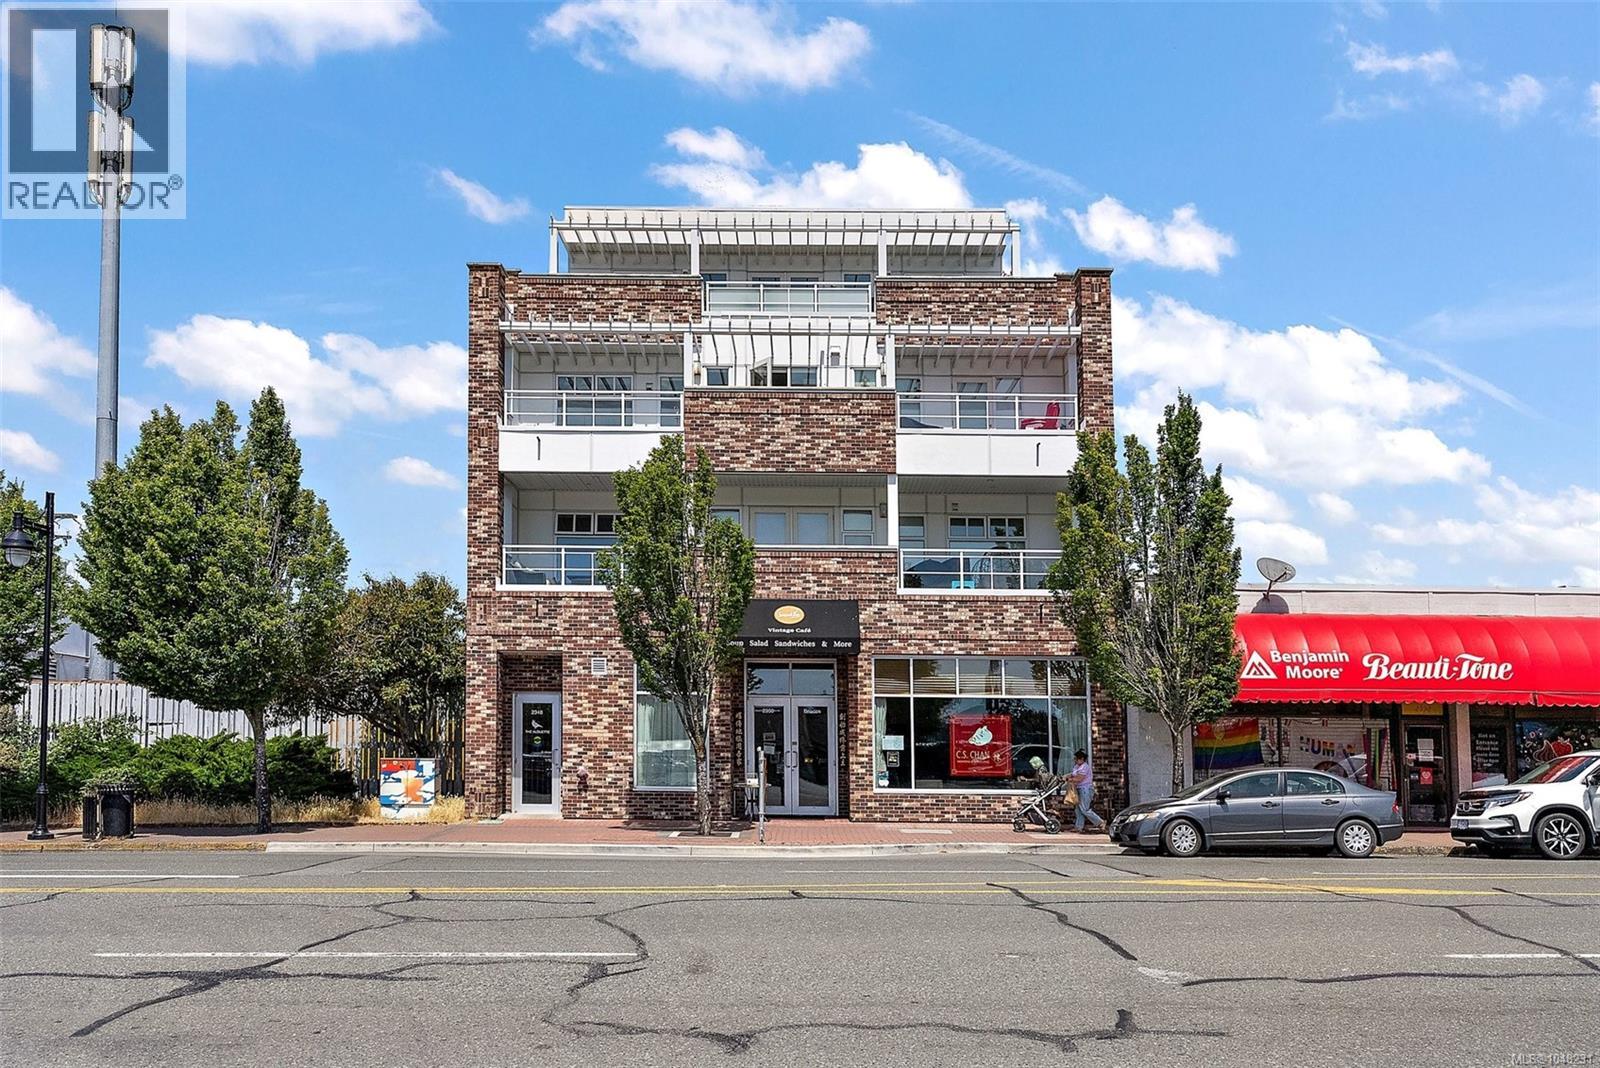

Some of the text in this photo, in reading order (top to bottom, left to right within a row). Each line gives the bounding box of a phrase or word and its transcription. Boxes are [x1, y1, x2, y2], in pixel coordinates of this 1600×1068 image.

[1270, 651, 1349, 665] Benjamin
[1362, 653, 1514, 681] Beauti-Tone
[970, 750, 991, 760] CHAN
